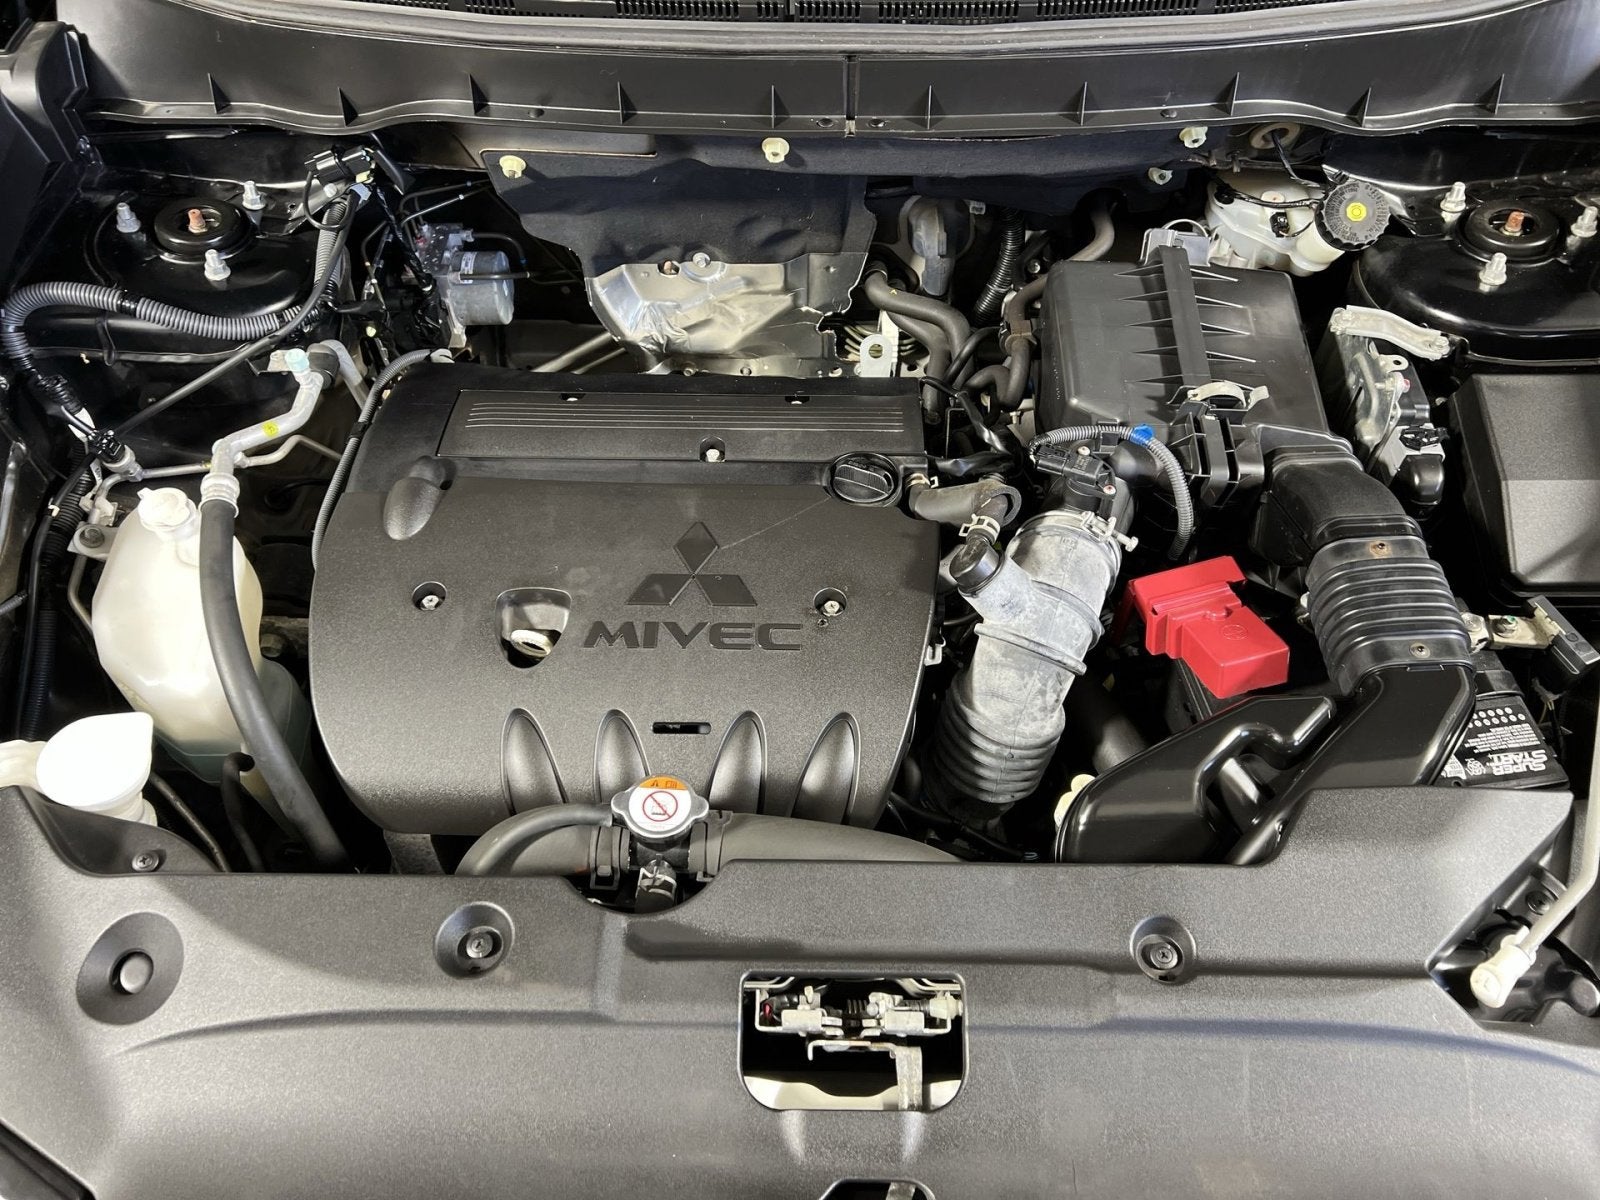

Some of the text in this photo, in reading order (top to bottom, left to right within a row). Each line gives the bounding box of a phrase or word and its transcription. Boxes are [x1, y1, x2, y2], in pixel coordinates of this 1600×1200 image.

[584, 620, 804, 651] MIVEC
[1492, 749, 1548, 765] START
[1493, 761, 1546, 776] SUPER
